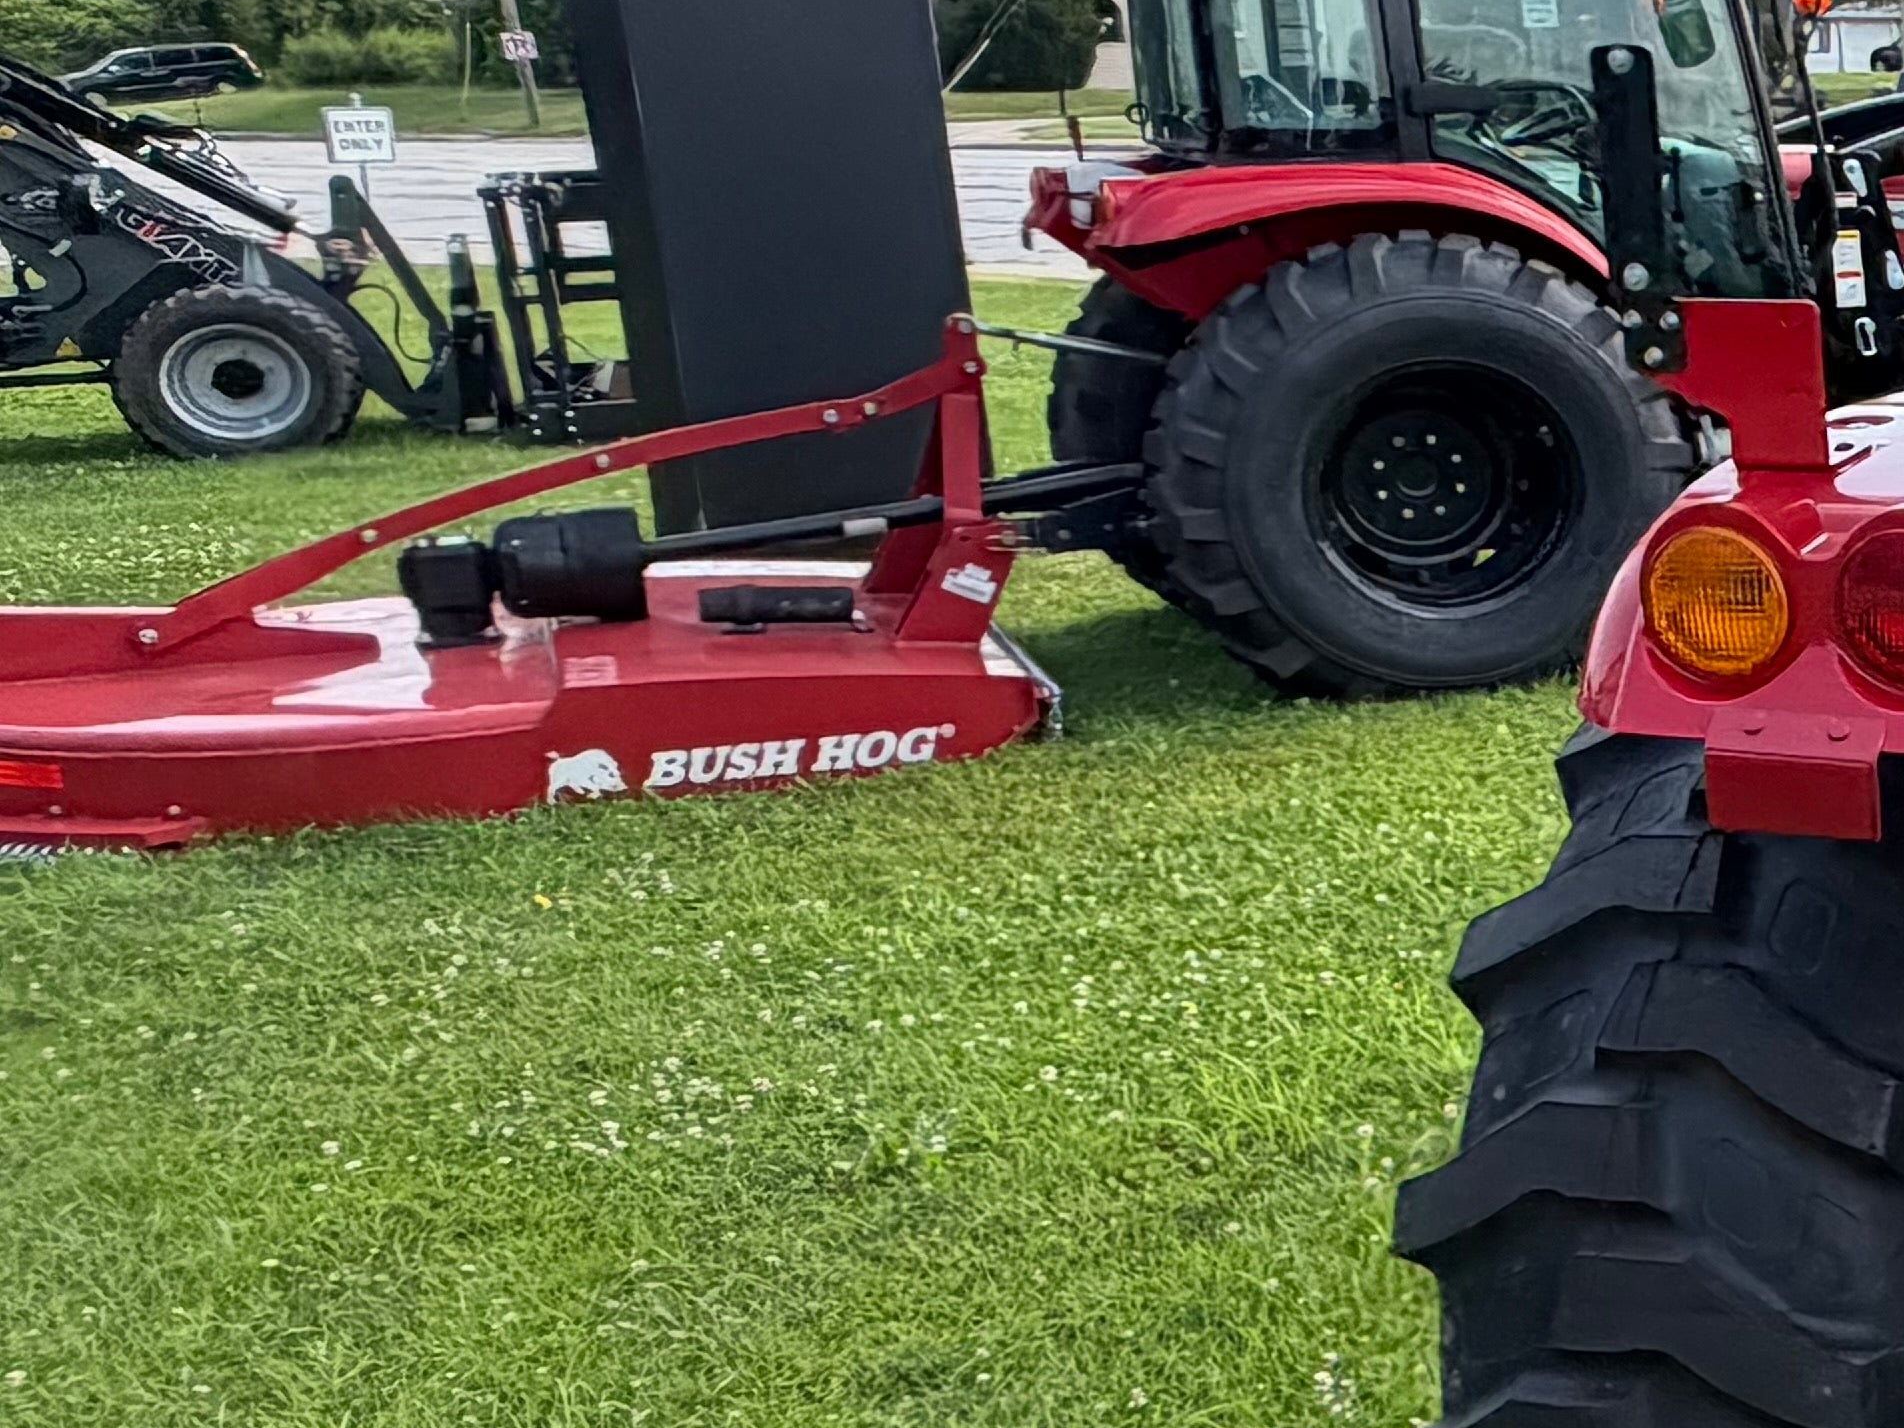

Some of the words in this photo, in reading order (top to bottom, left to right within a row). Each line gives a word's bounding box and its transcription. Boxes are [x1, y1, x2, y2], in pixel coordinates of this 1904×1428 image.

[333, 120, 387, 133] ENTER
[338, 138, 384, 151] ONLY
[643, 739, 806, 787] BUSH
[811, 725, 939, 772] HOG
